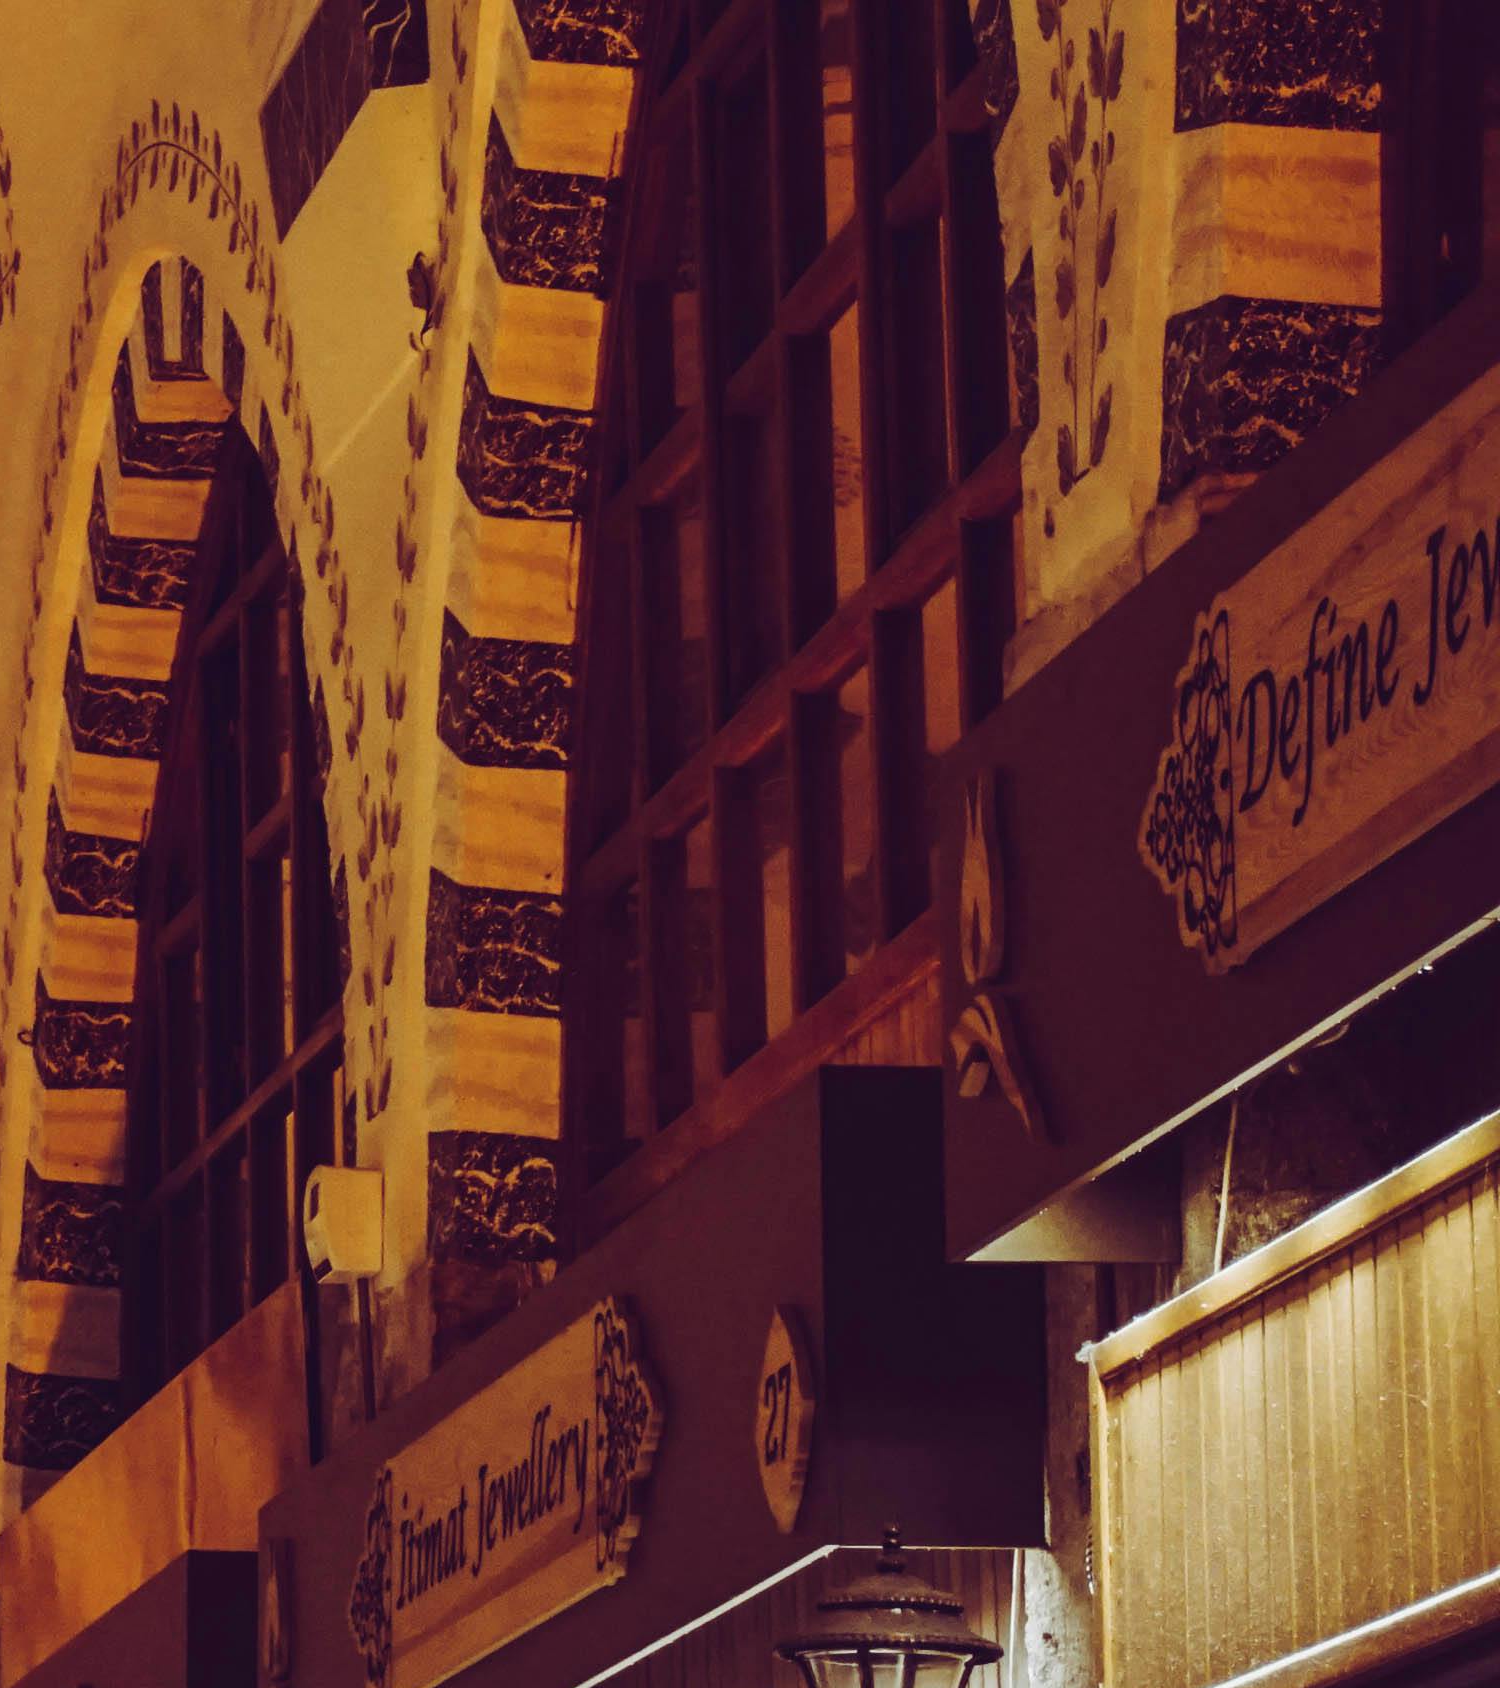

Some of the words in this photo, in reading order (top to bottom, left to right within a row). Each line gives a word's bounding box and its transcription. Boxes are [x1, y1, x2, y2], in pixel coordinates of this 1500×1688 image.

[1237, 597, 1400, 828] Define
[472, 1404, 588, 1577] Jewellery
[764, 1363, 791, 1467] 27
